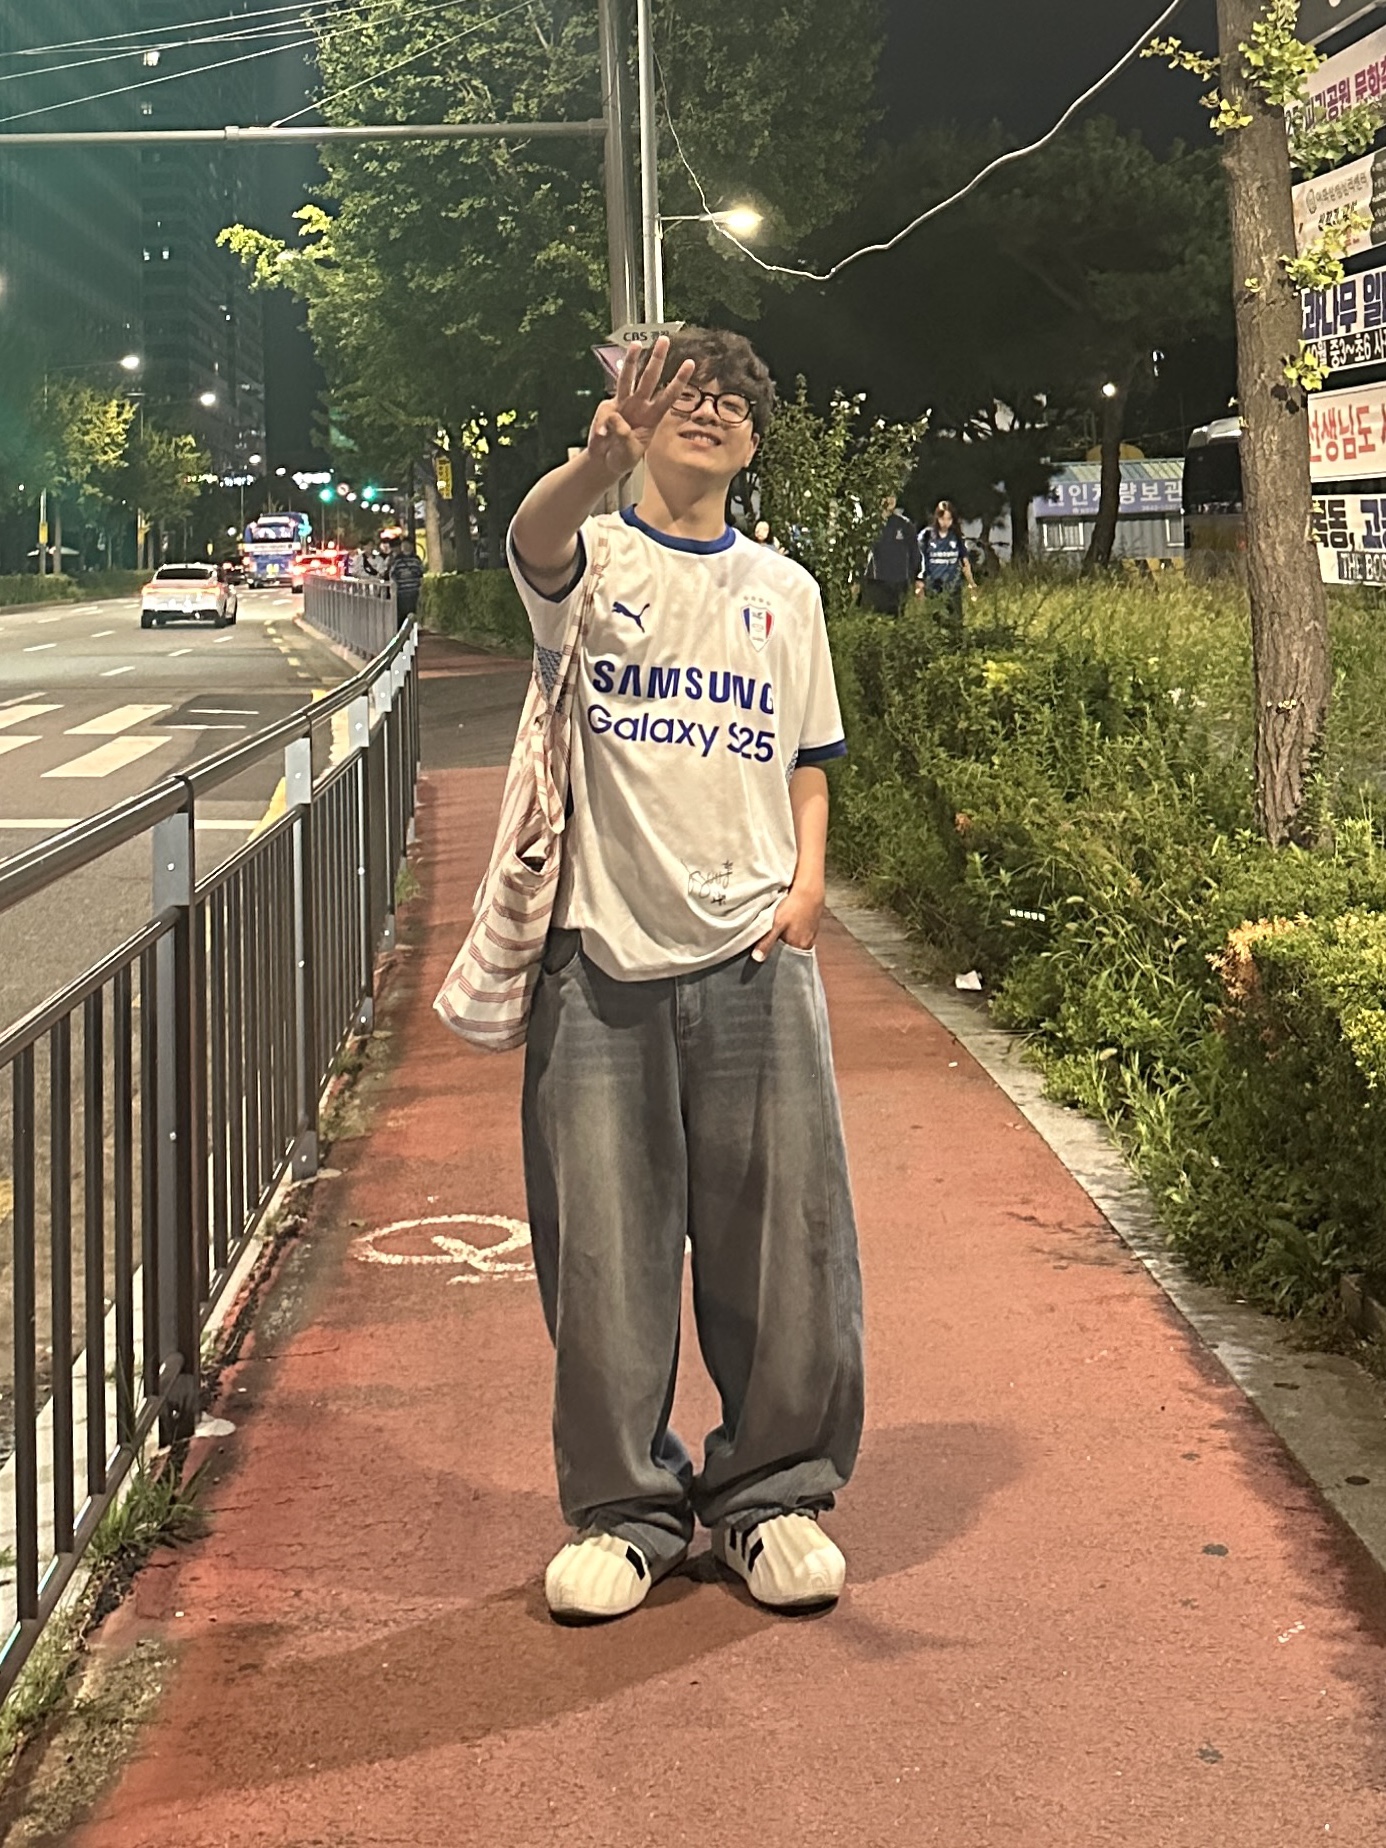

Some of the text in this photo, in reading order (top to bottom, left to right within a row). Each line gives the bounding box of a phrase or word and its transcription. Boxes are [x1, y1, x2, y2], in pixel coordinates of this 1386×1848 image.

[1303, 271, 1386, 340] 과나무 일
[622, 331, 648, 342] CBS
[1329, 333, 1371, 369] 중3~초6
[1374, 327, 1386, 359] 사
[1309, 403, 1376, 462] 선생님도
[1360, 499, 1386, 548] 고
[1340, 553, 1363, 579] THE
[592, 660, 775, 715] SAMSUNG
[587, 704, 775, 763] Galaxy S25
